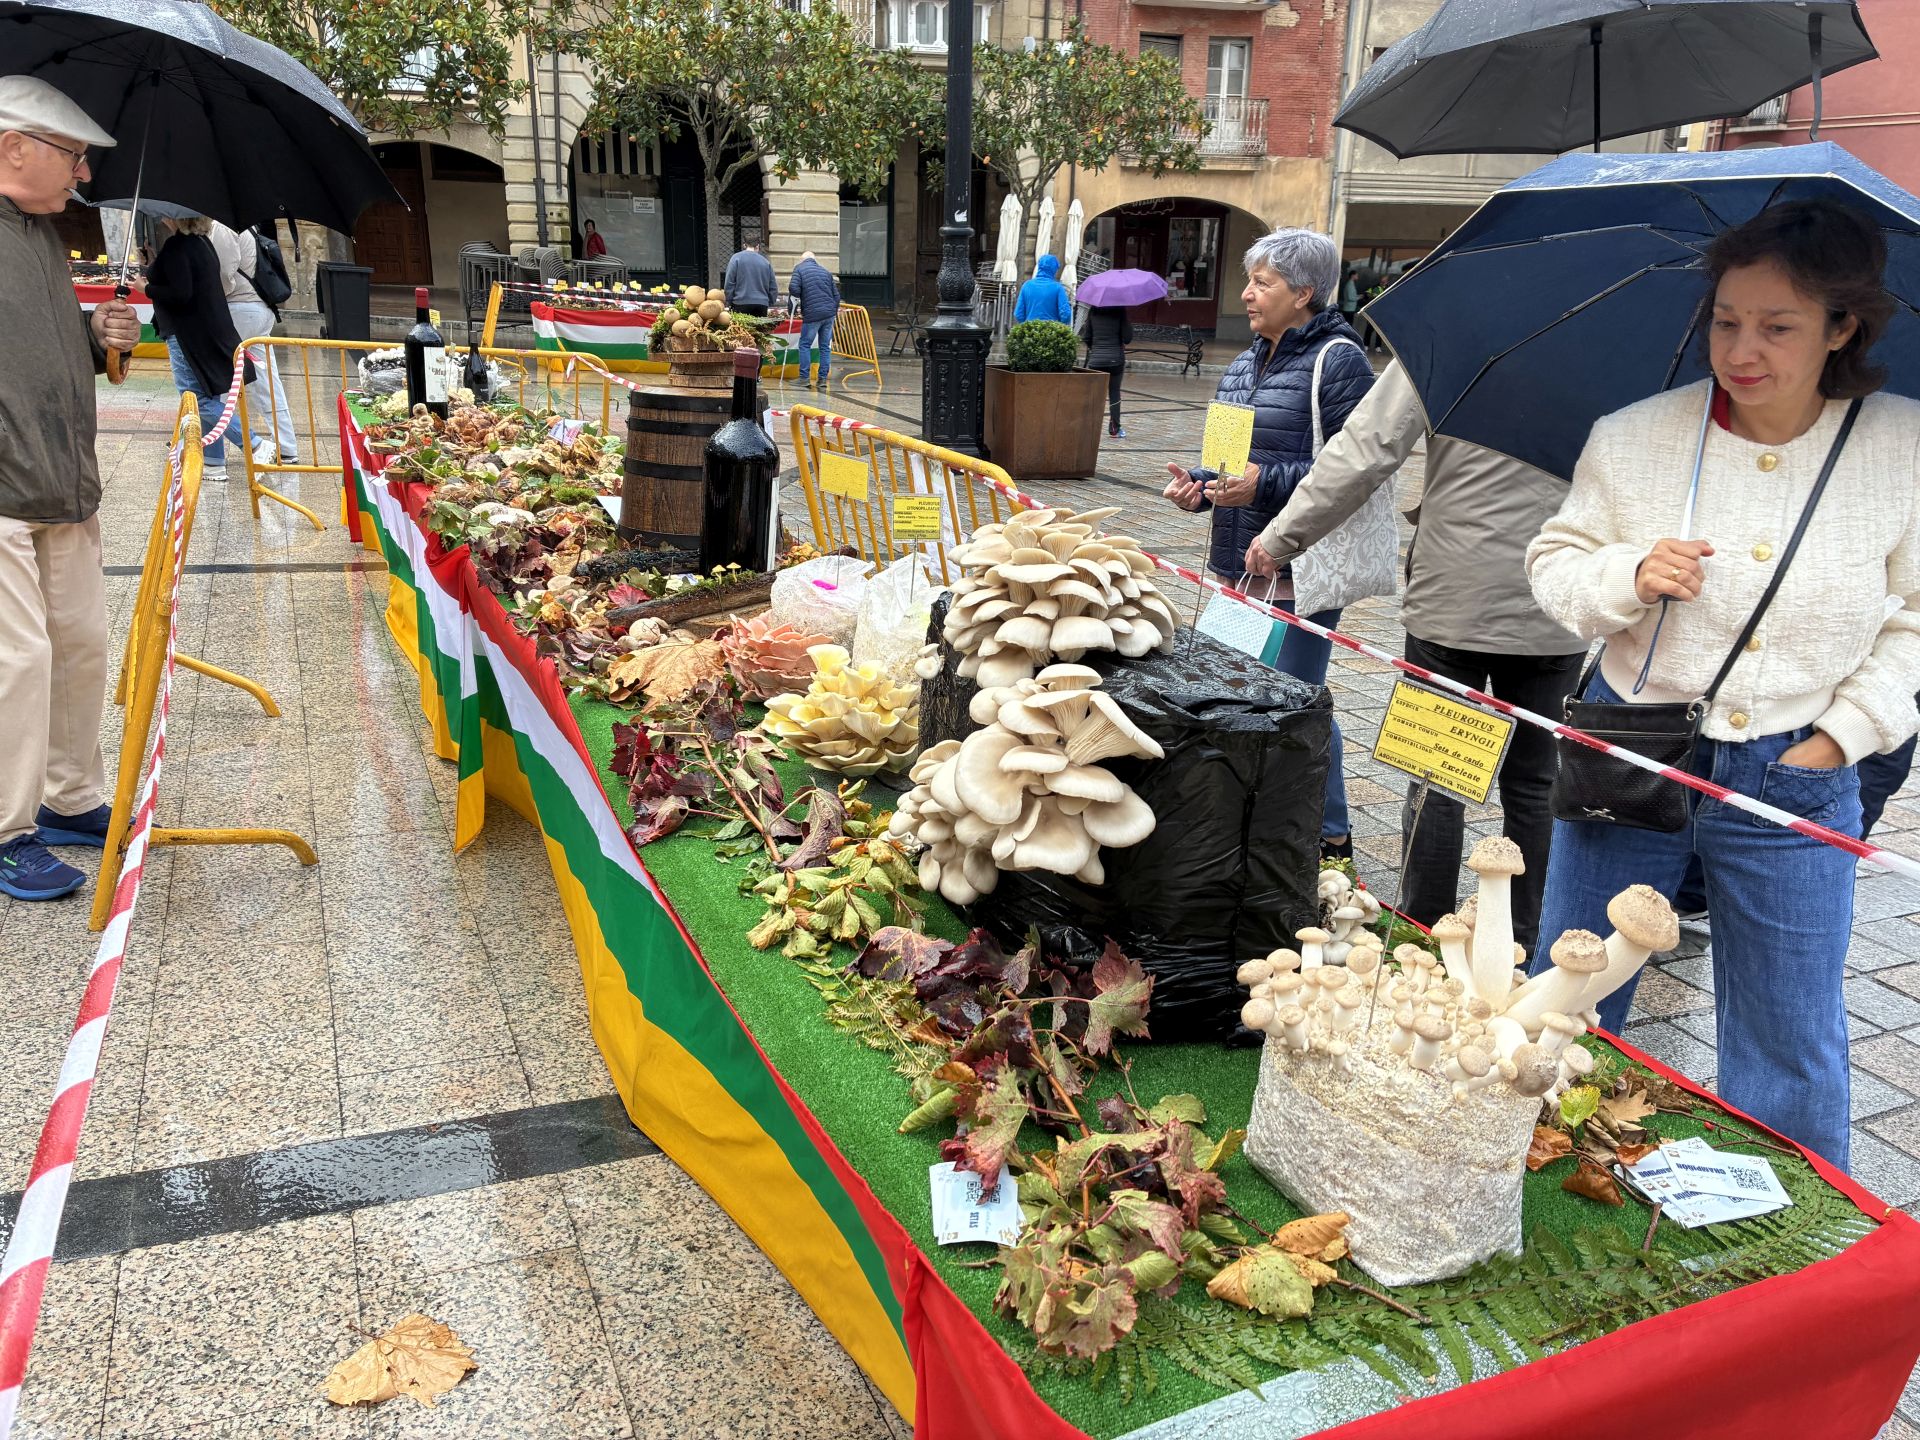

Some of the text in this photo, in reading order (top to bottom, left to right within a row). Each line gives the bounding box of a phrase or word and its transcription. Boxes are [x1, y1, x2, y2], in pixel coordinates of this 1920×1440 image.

[1393, 717, 1417, 729] NOMBRE
[1433, 703, 1495, 733] PLEUROTUS
[1449, 725, 1497, 749] ERYNGII
[1378, 751, 1417, 771] ASOCIACION
[1433, 742, 1485, 769] Seta de cardo
[1440, 759, 1482, 783] Excelente
